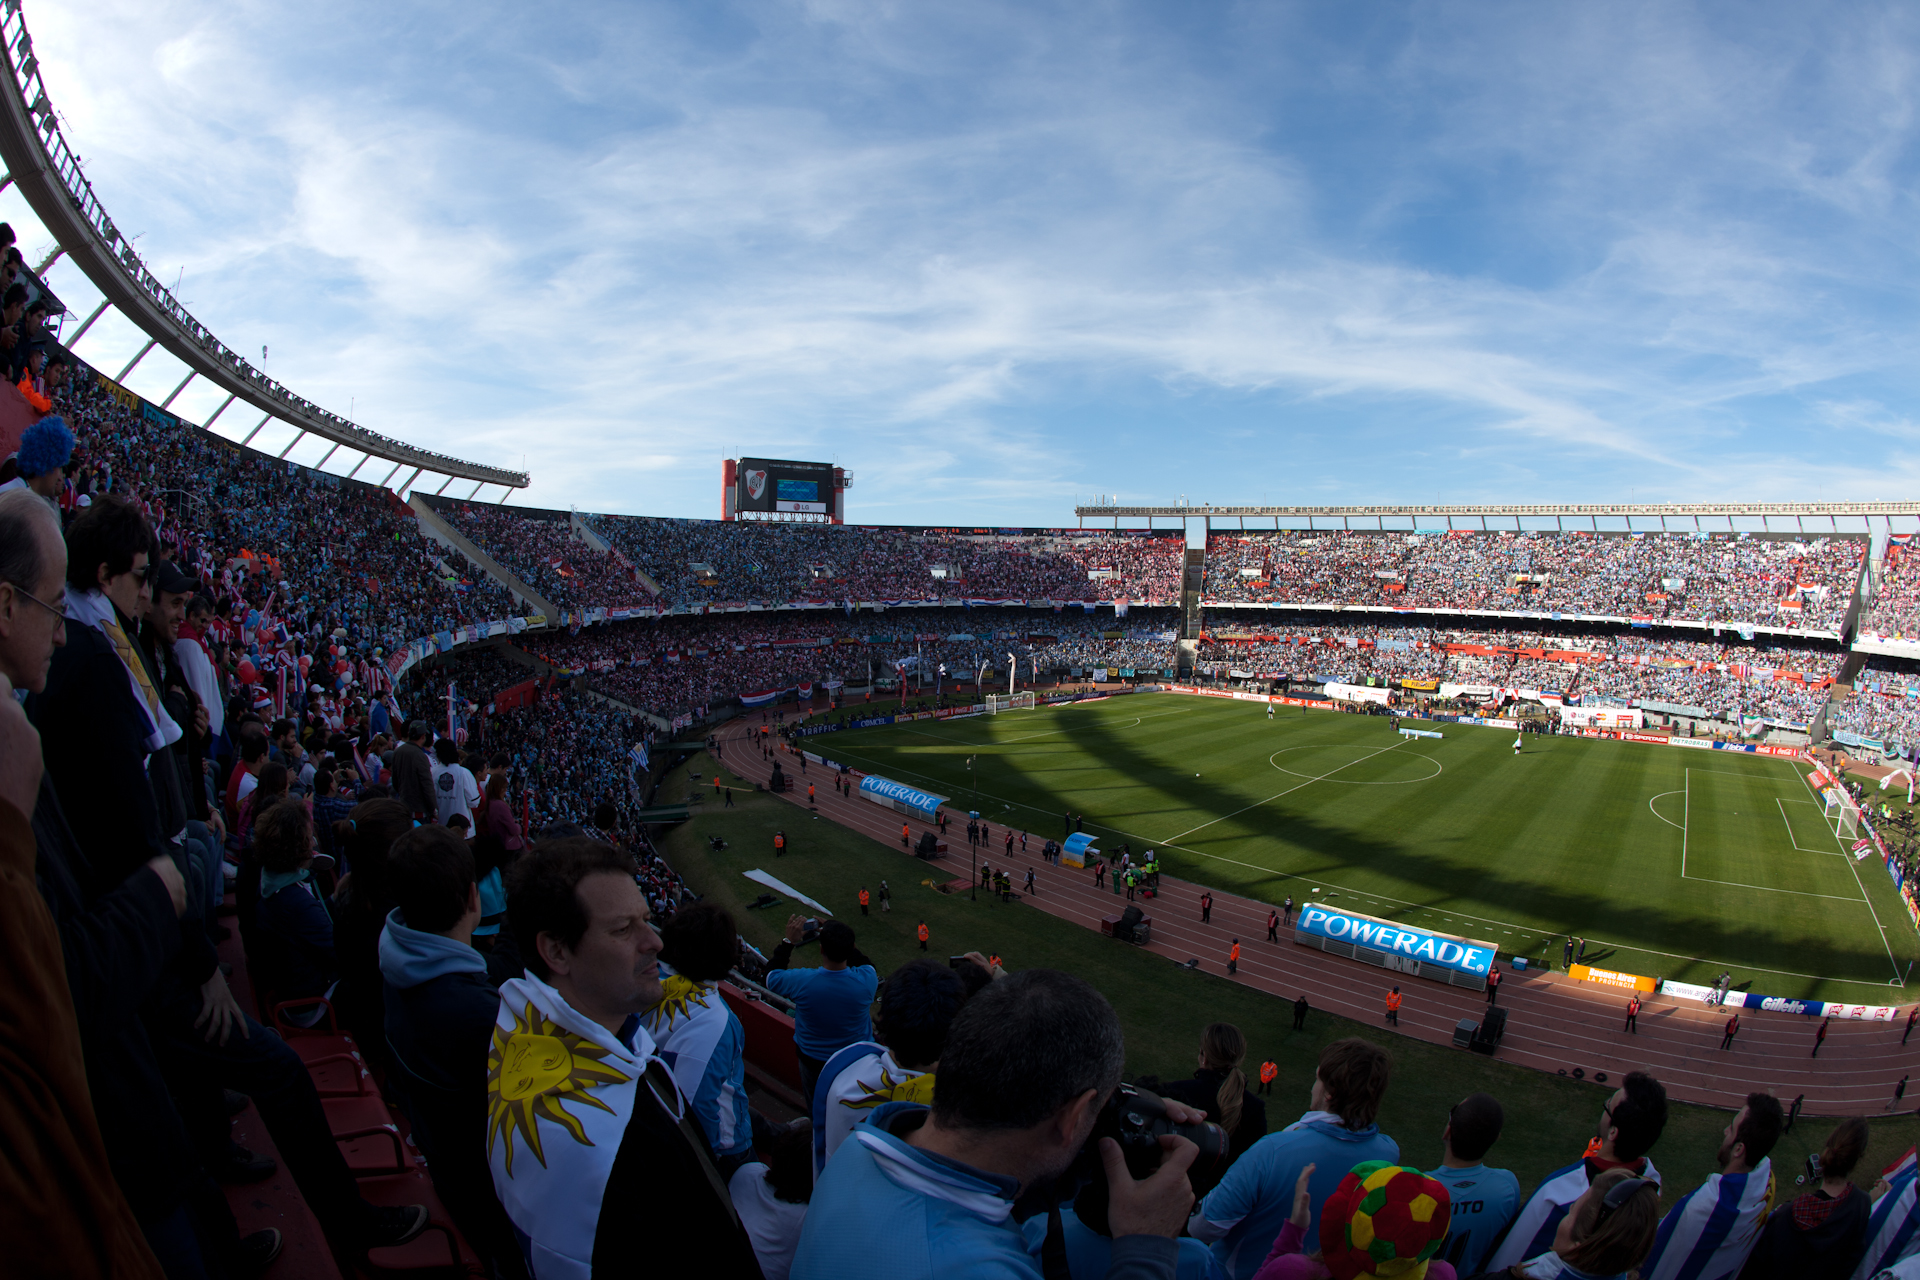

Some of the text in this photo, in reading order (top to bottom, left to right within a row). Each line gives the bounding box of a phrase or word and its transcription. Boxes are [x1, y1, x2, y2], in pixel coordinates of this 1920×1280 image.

[1048, 694, 1075, 702] MasterCard
[860, 717, 886, 728] COMCEL
[802, 724, 837, 736] TRAFFIC
[1633, 733, 1668, 744] SPORTAGE
[1672, 738, 1709, 748] PETROBRAS
[1776, 748, 1793, 756] Coca-Cola
[862, 776, 936, 810] POWERADE
[1302, 909, 1483, 972] POWERADE
[1588, 967, 1637, 984] Buenos Aires
[1596, 978, 1635, 989] PROVINCIA
[1760, 996, 1805, 1014] Gillette
[1450, 1200, 1484, 1215] ITO
